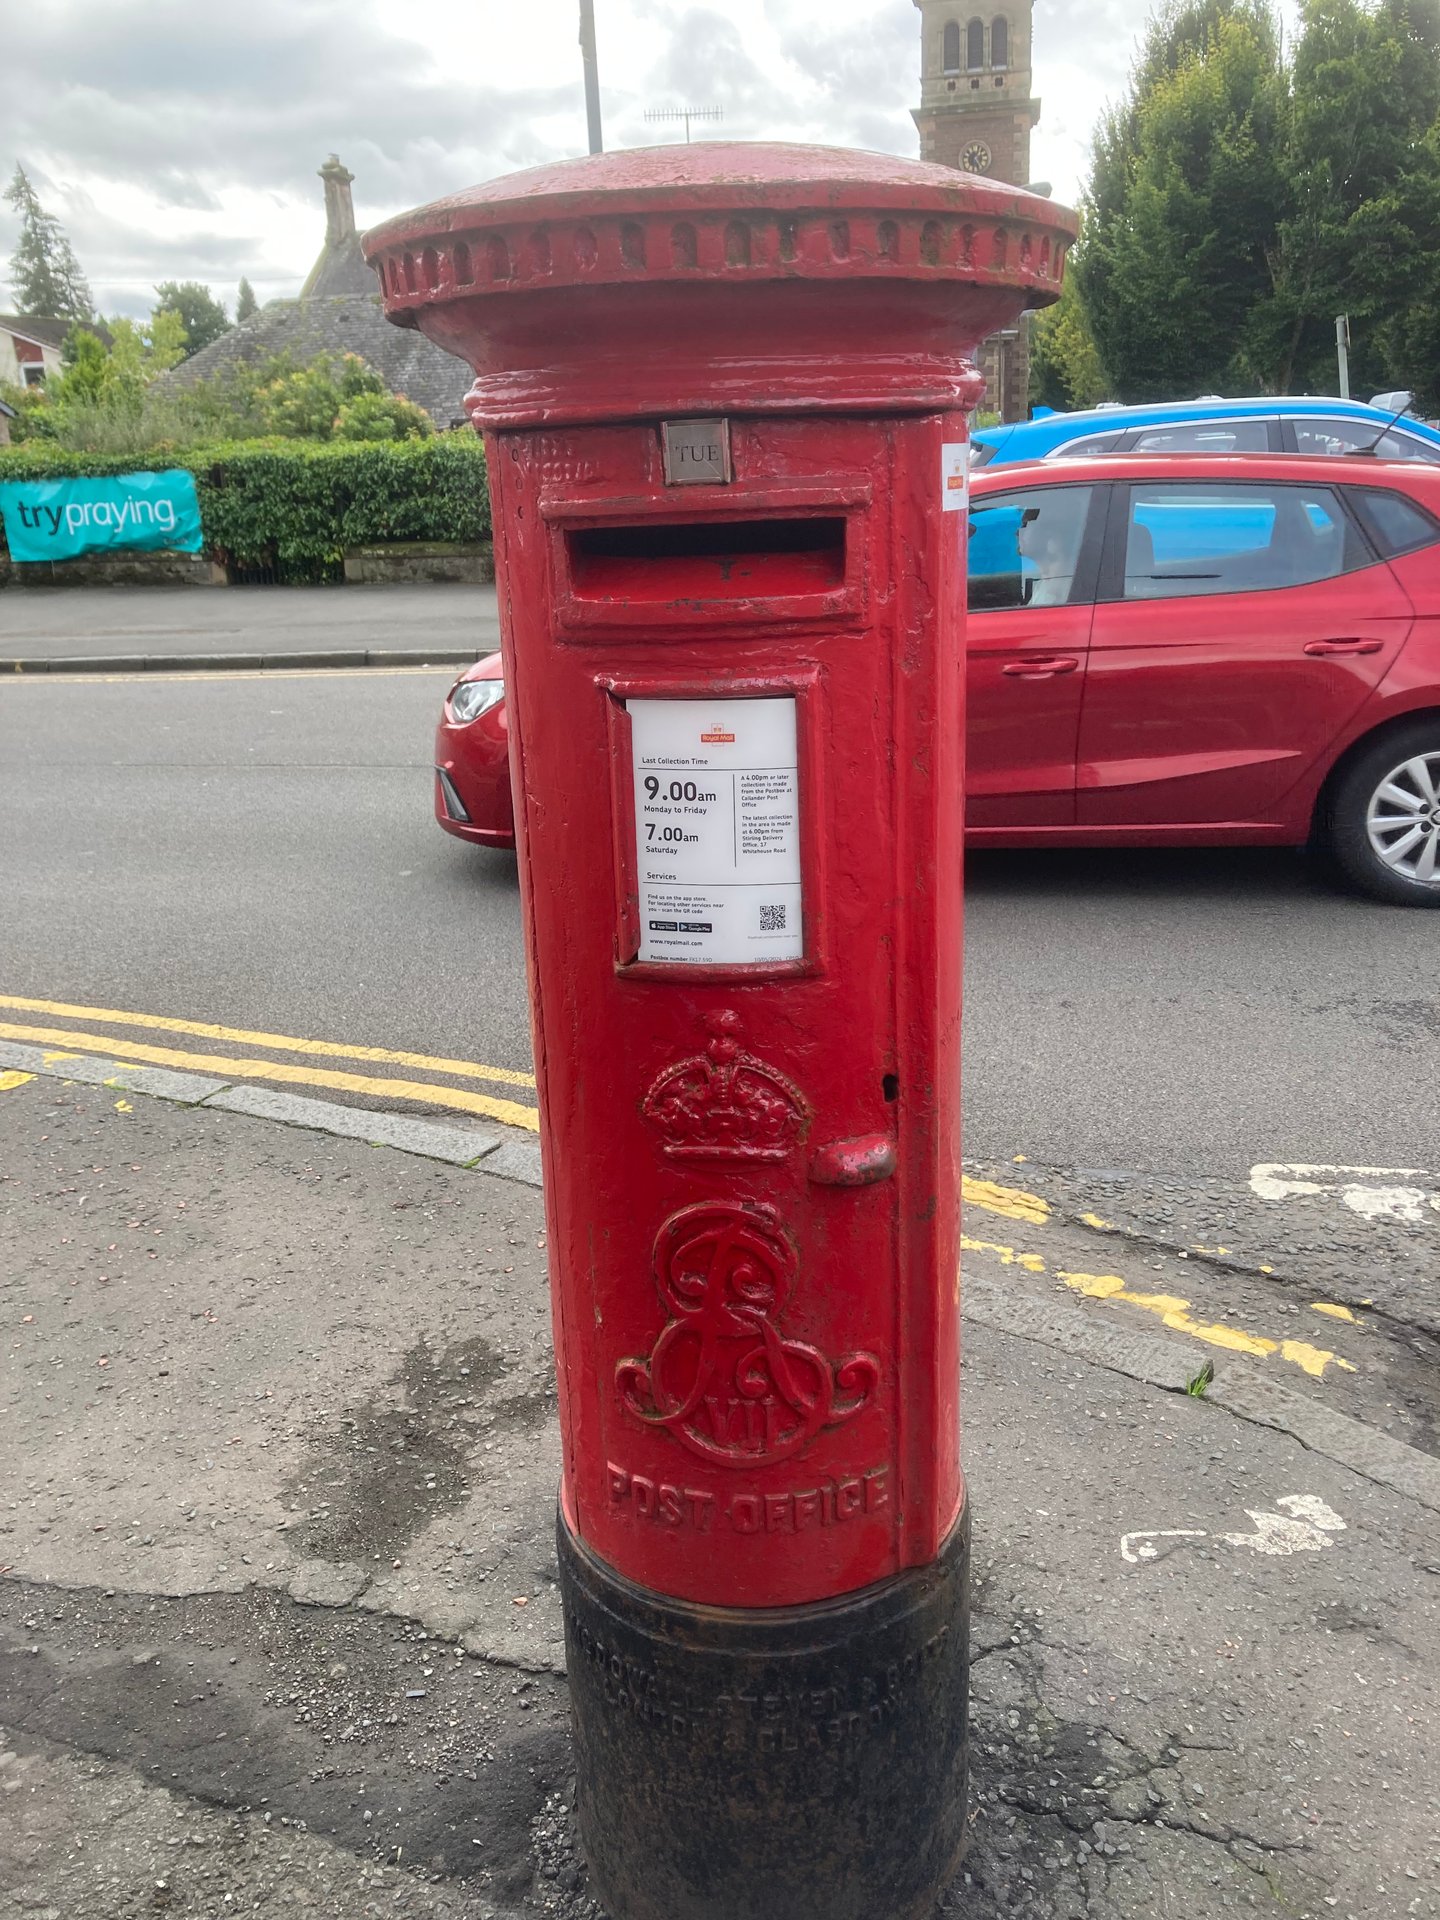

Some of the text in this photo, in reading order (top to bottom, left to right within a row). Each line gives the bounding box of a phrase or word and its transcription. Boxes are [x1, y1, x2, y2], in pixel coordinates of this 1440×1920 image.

[675, 445, 719, 463] TUE
[642, 757, 709, 765] Last Collection Time
[644, 775, 717, 802] 9.00am
[644, 805, 672, 814] Monday
[684, 806, 707, 815] Friday
[645, 823, 699, 843] 7.00am
[645, 846, 678, 855] Saturday
[646, 871, 677, 881] Services
[606, 1460, 890, 1535] POST OFFICE
